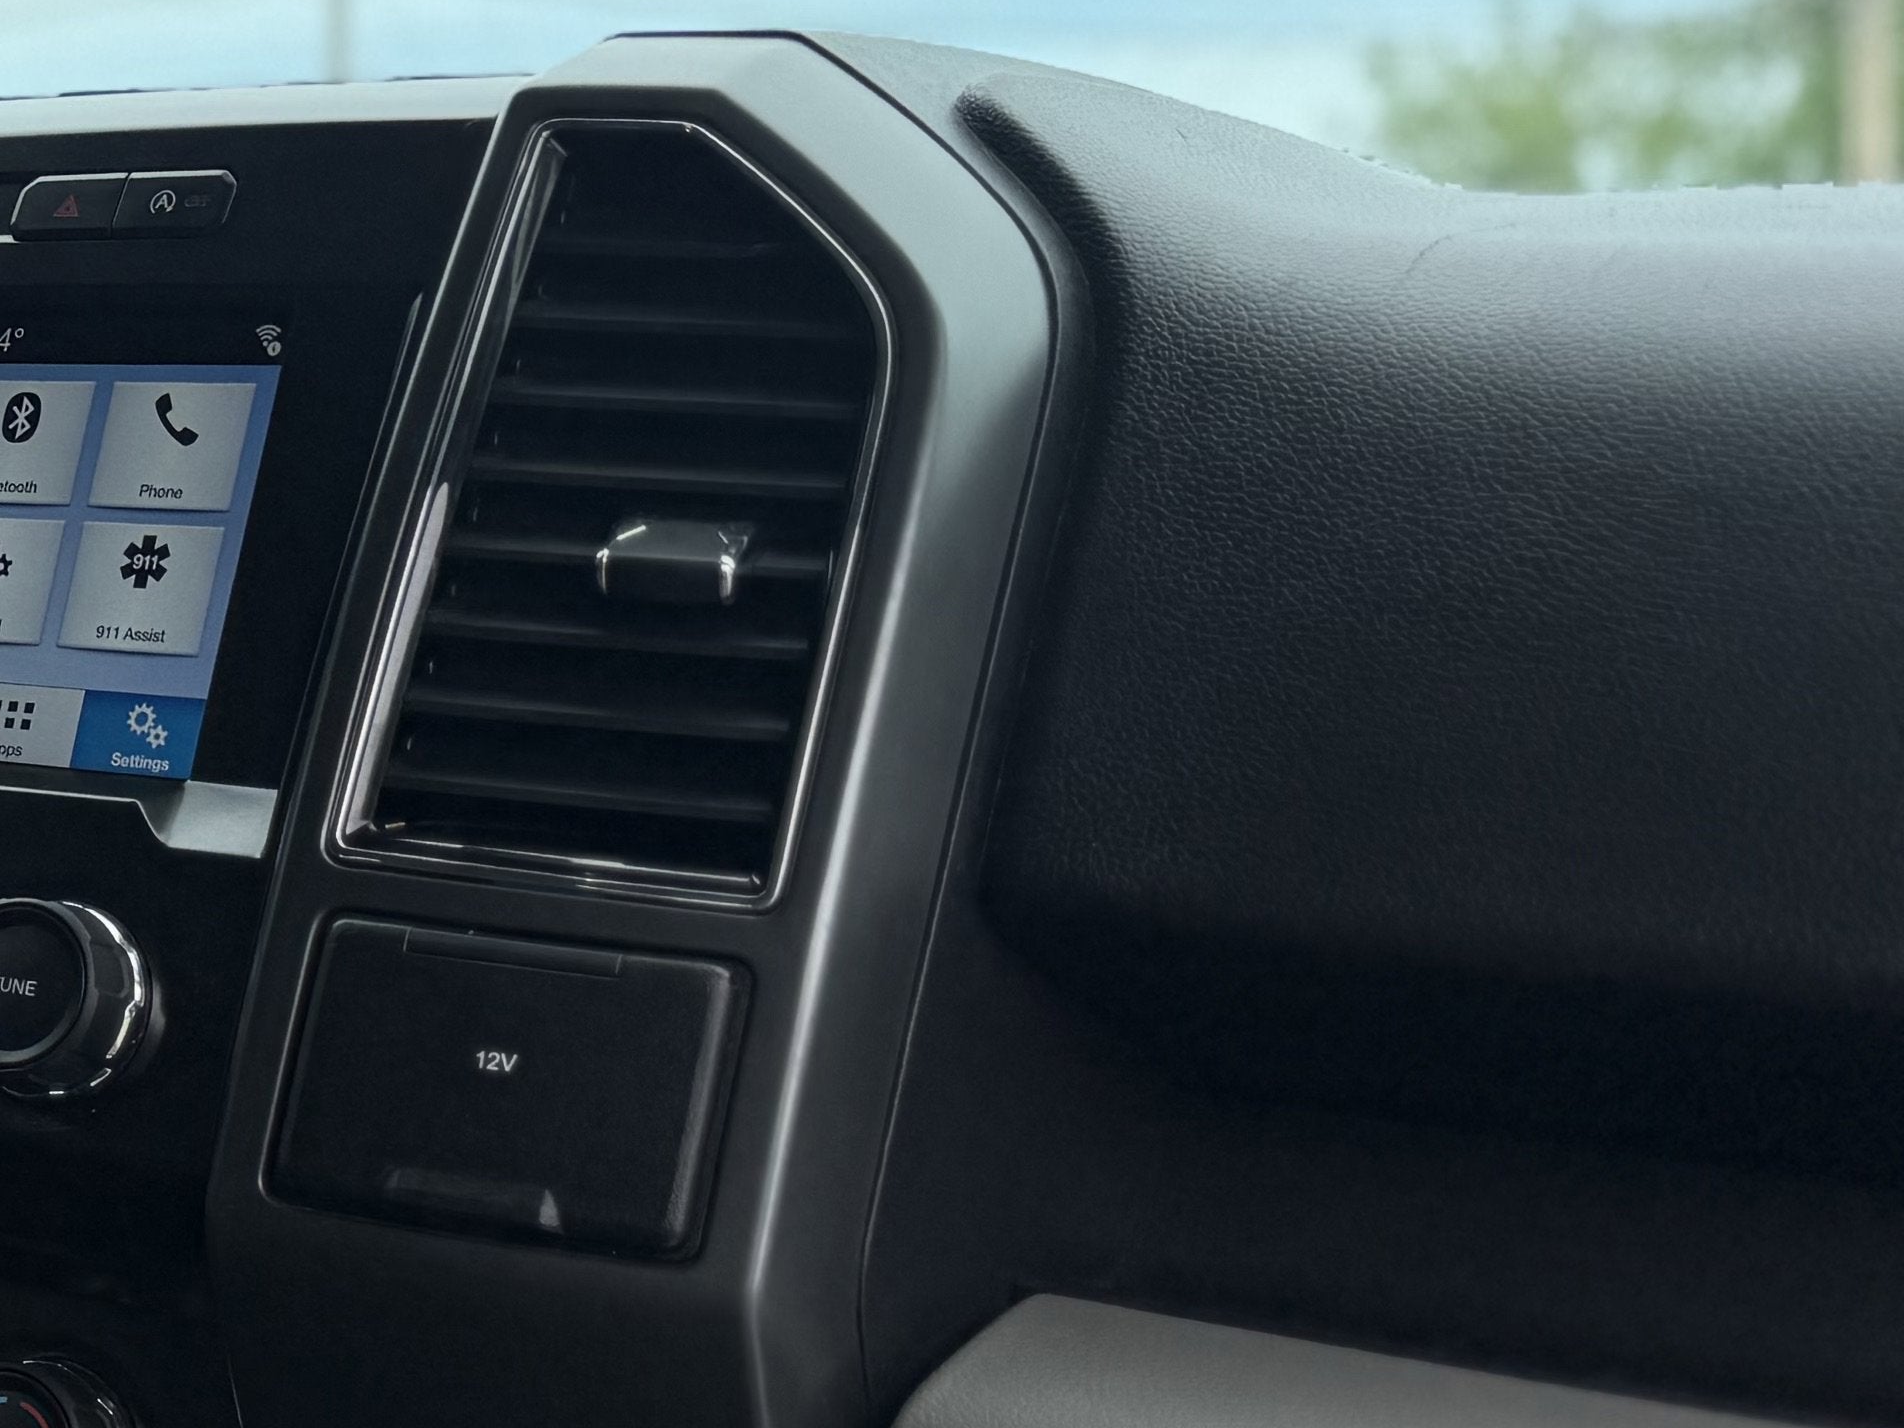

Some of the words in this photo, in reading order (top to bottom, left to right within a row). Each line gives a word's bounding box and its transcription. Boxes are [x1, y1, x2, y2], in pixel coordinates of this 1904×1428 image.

[138, 483, 184, 501] Phone
[132, 553, 159, 571] 911
[95, 625, 120, 642] 911
[122, 626, 167, 644] Assist
[110, 751, 170, 774] Settings
[475, 1050, 519, 1072] 12V
